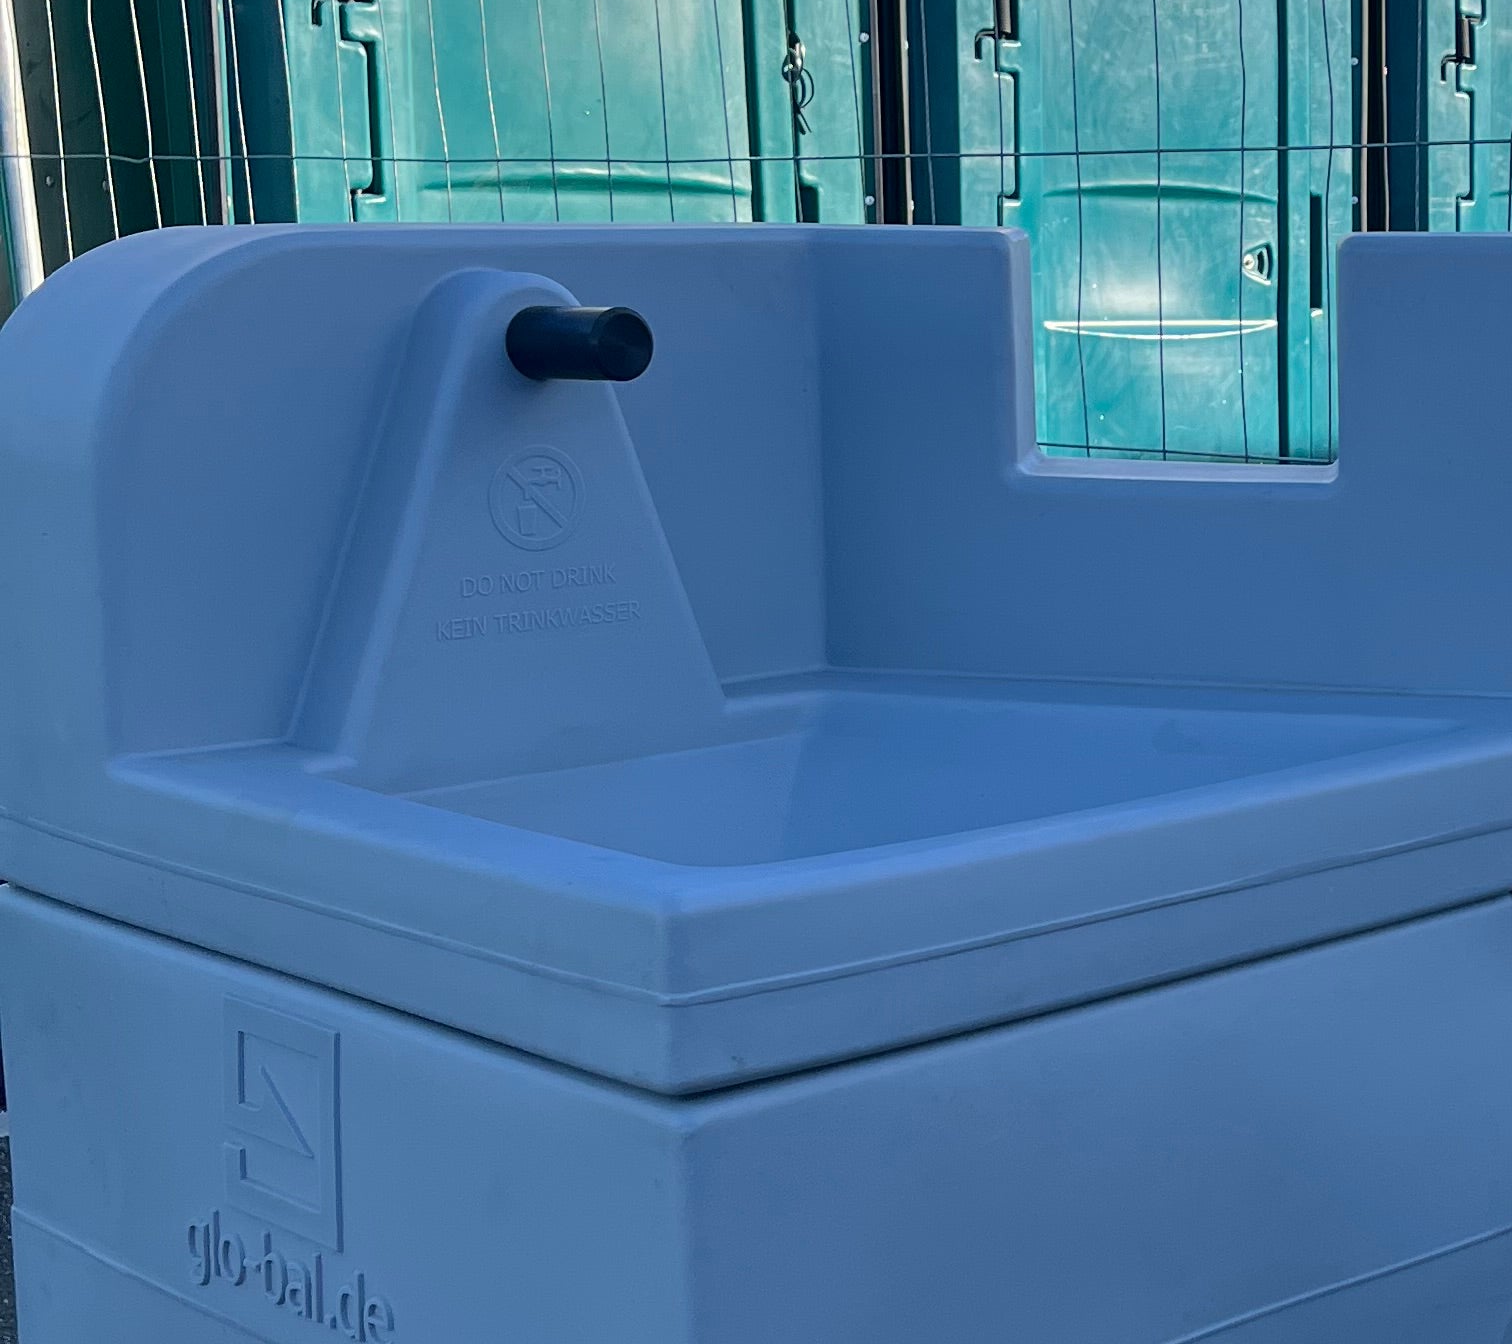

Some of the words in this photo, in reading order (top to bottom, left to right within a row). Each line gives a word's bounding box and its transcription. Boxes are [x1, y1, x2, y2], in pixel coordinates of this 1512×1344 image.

[462, 575, 494, 598] DO
[501, 569, 545, 594] NOT
[551, 562, 617, 590] DRINK
[437, 615, 488, 642] KEIN
[493, 599, 641, 633] TRINKWASSER
